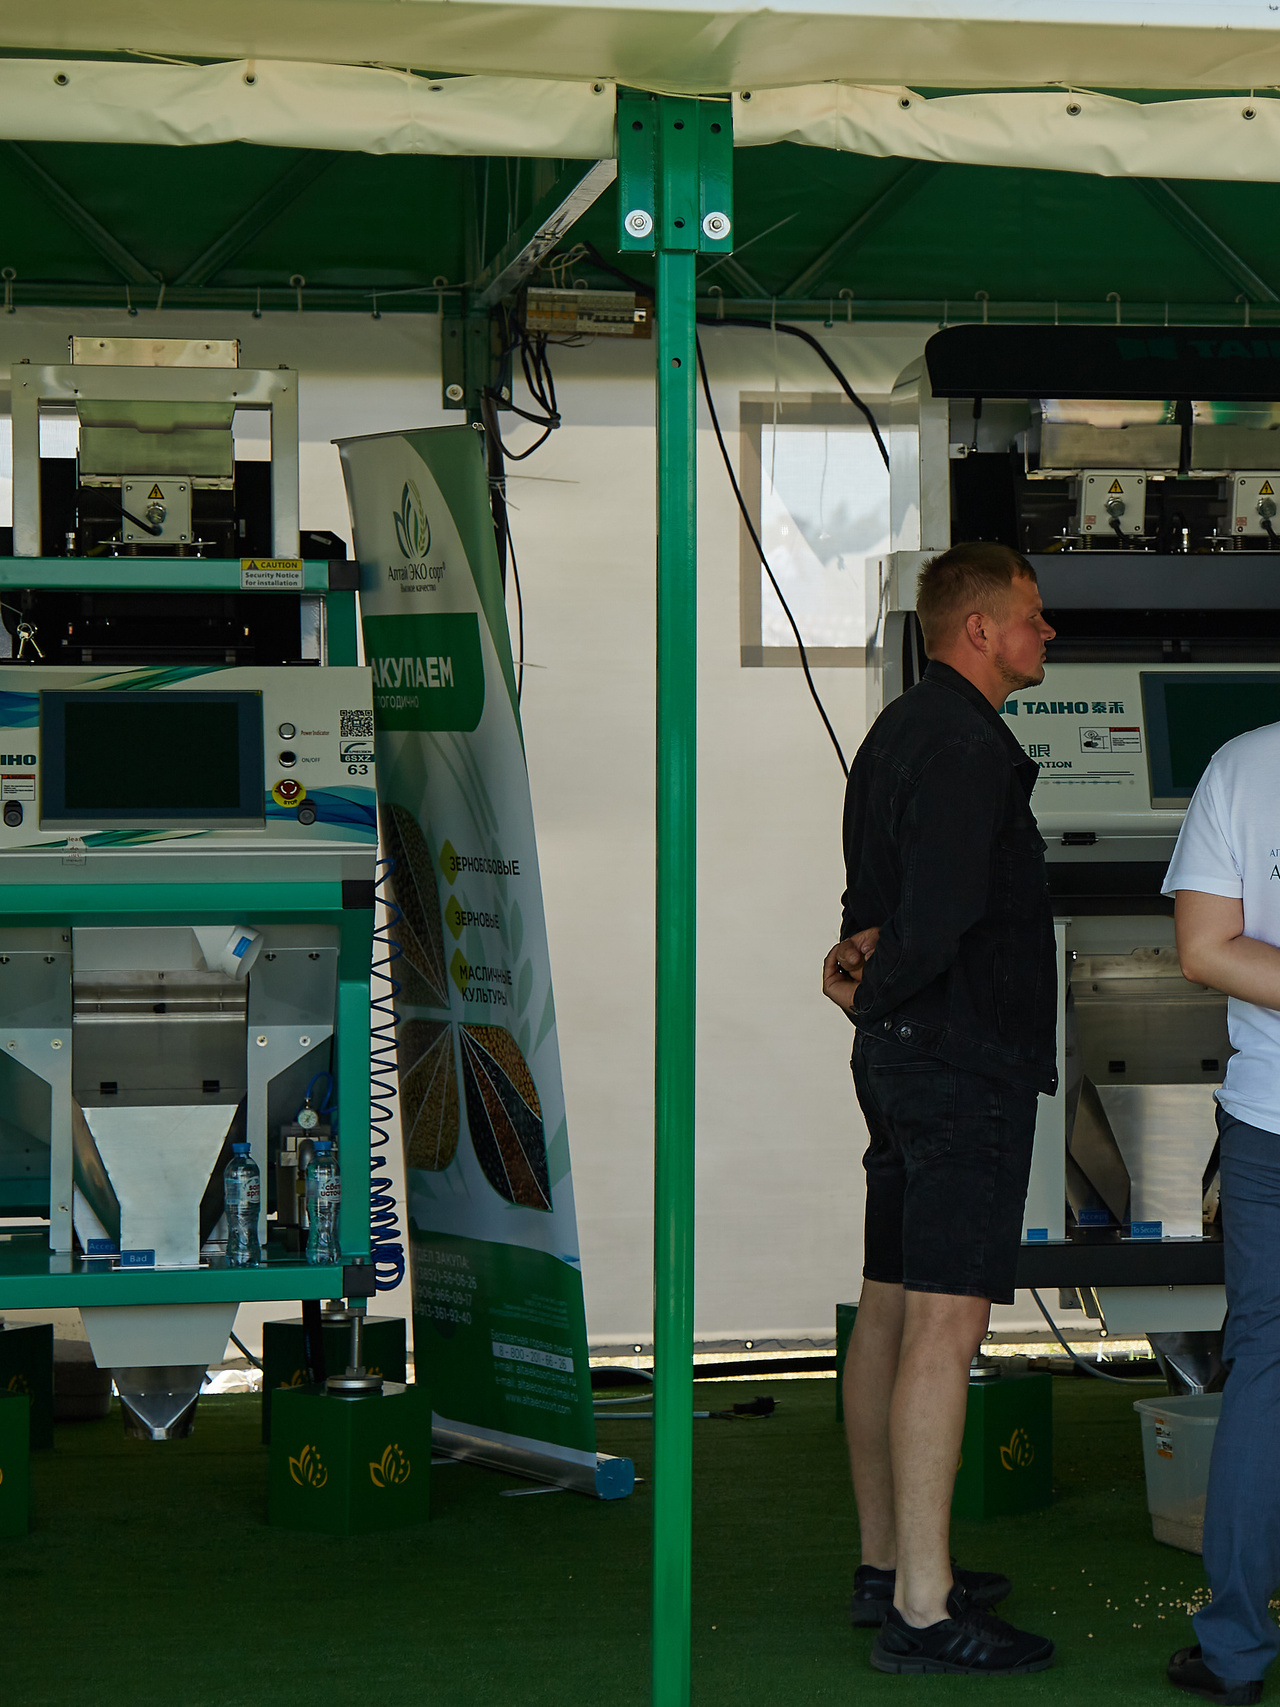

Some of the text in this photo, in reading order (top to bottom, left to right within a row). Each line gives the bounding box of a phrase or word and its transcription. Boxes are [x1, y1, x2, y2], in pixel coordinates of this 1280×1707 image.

[260, 561, 299, 569] CAUTION
[408, 562, 428, 581] ЭКО
[245, 571, 300, 580] Security Notice
[371, 656, 455, 689] АКУПАЕМ
[1022, 701, 1125, 715] TAIHO 泰禾
[347, 763, 369, 776] 63
[449, 855, 521, 876] ЗЕРНОБОБОВЫЕ
[454, 910, 500, 929] ЗЕРНОВЫЕ
[459, 965, 513, 985] МАСЛИЧНЫЕ
[461, 987, 509, 1007] КУЛЬТУРЫ
[89, 1242, 116, 1252] Accep
[129, 1255, 148, 1263] Bad
